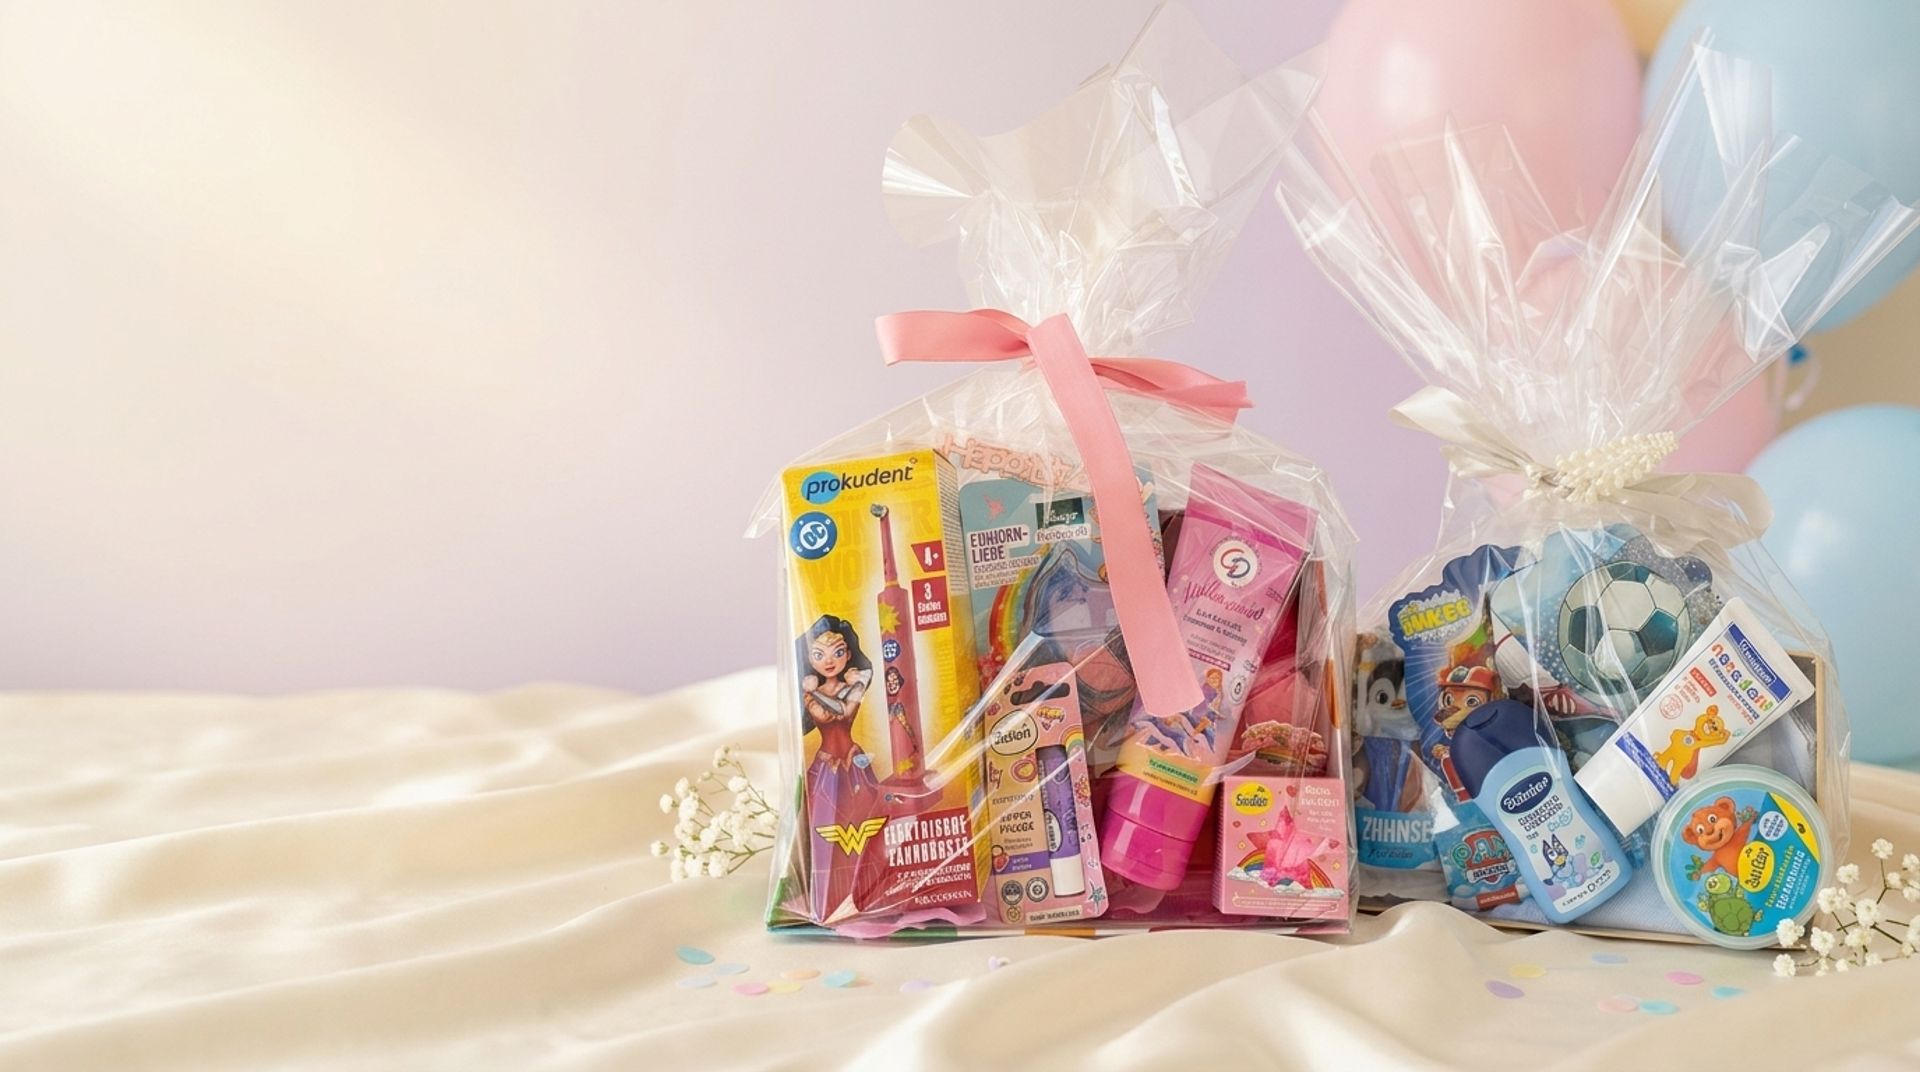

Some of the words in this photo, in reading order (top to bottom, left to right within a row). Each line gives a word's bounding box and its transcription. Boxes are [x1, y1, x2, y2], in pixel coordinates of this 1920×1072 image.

[806, 466, 914, 501] prokudent
[972, 546, 1006, 564] LIEBE
[924, 583, 932, 601] 3
